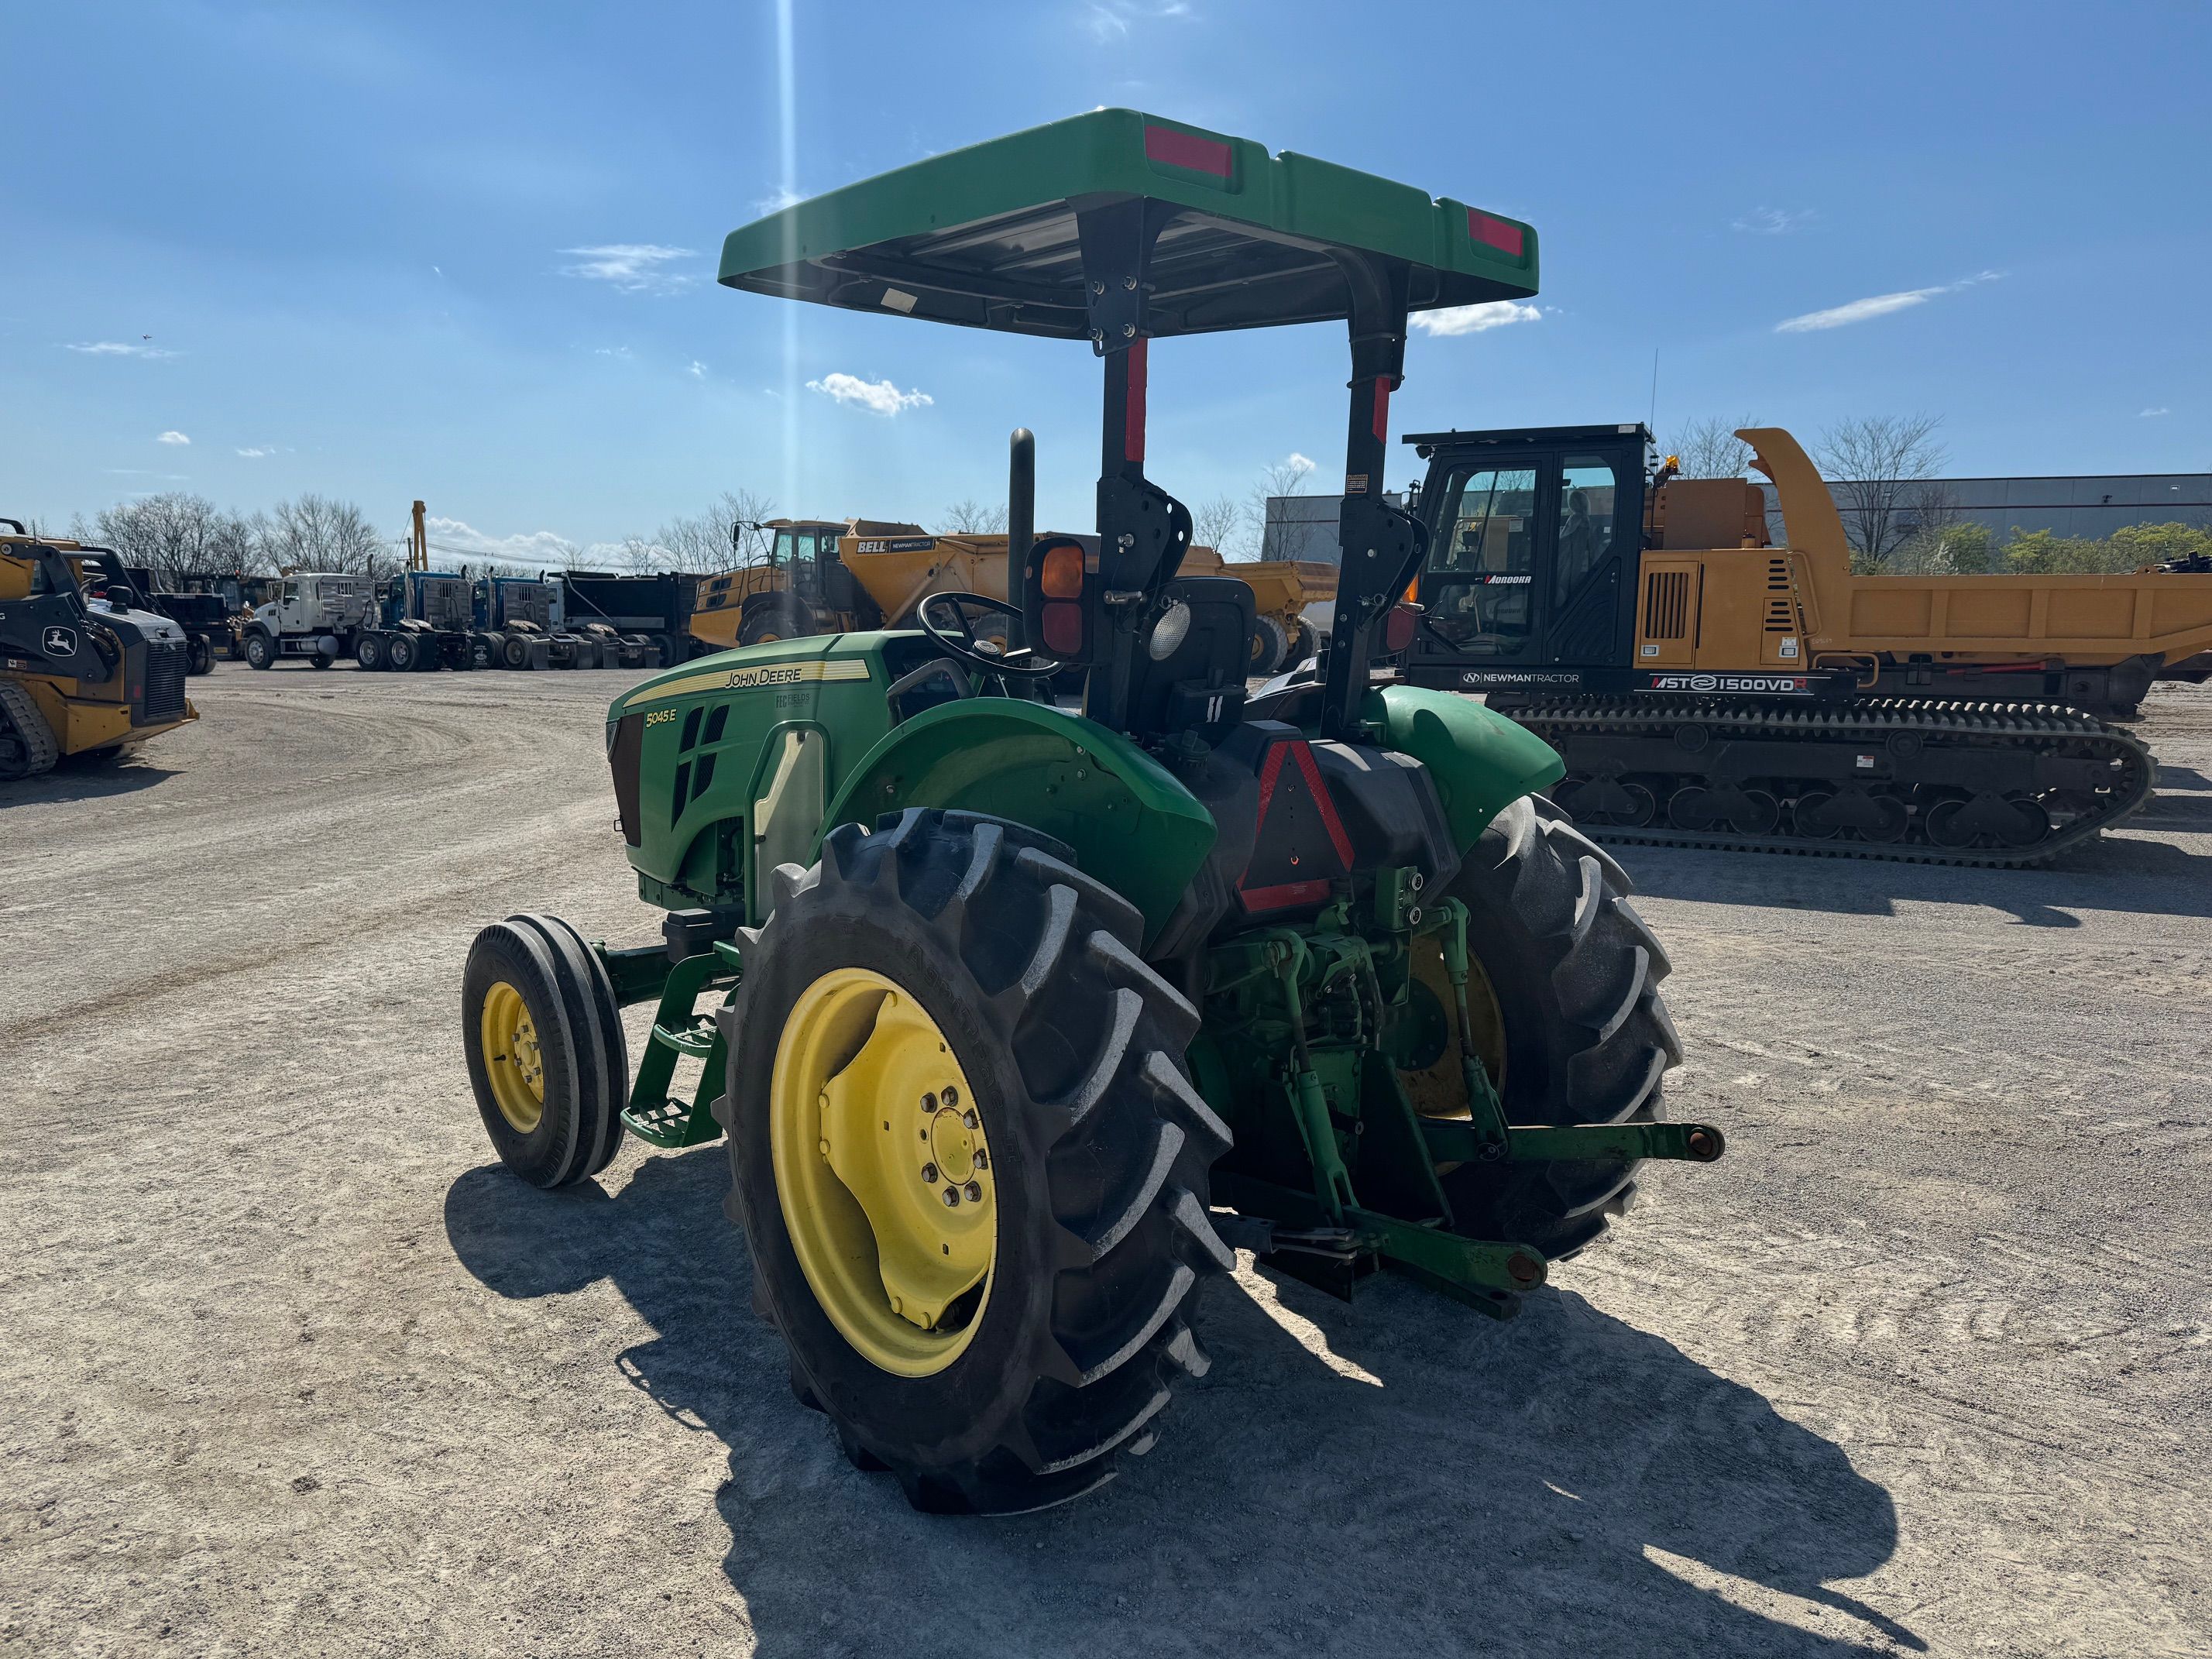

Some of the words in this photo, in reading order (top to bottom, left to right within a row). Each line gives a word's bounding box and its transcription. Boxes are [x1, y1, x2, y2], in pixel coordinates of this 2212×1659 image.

[857, 541, 886, 553] BELL
[892, 541, 931, 549] NEWMANTRACTOR
[725, 672, 757, 687] JOHN
[759, 668, 802, 684] DEERE
[1483, 673, 1579, 682] NEWMANTRACTOR
[1650, 677, 1691, 689] MST
[775, 694, 788, 709] FEC
[788, 693, 810, 702] FIELDS
